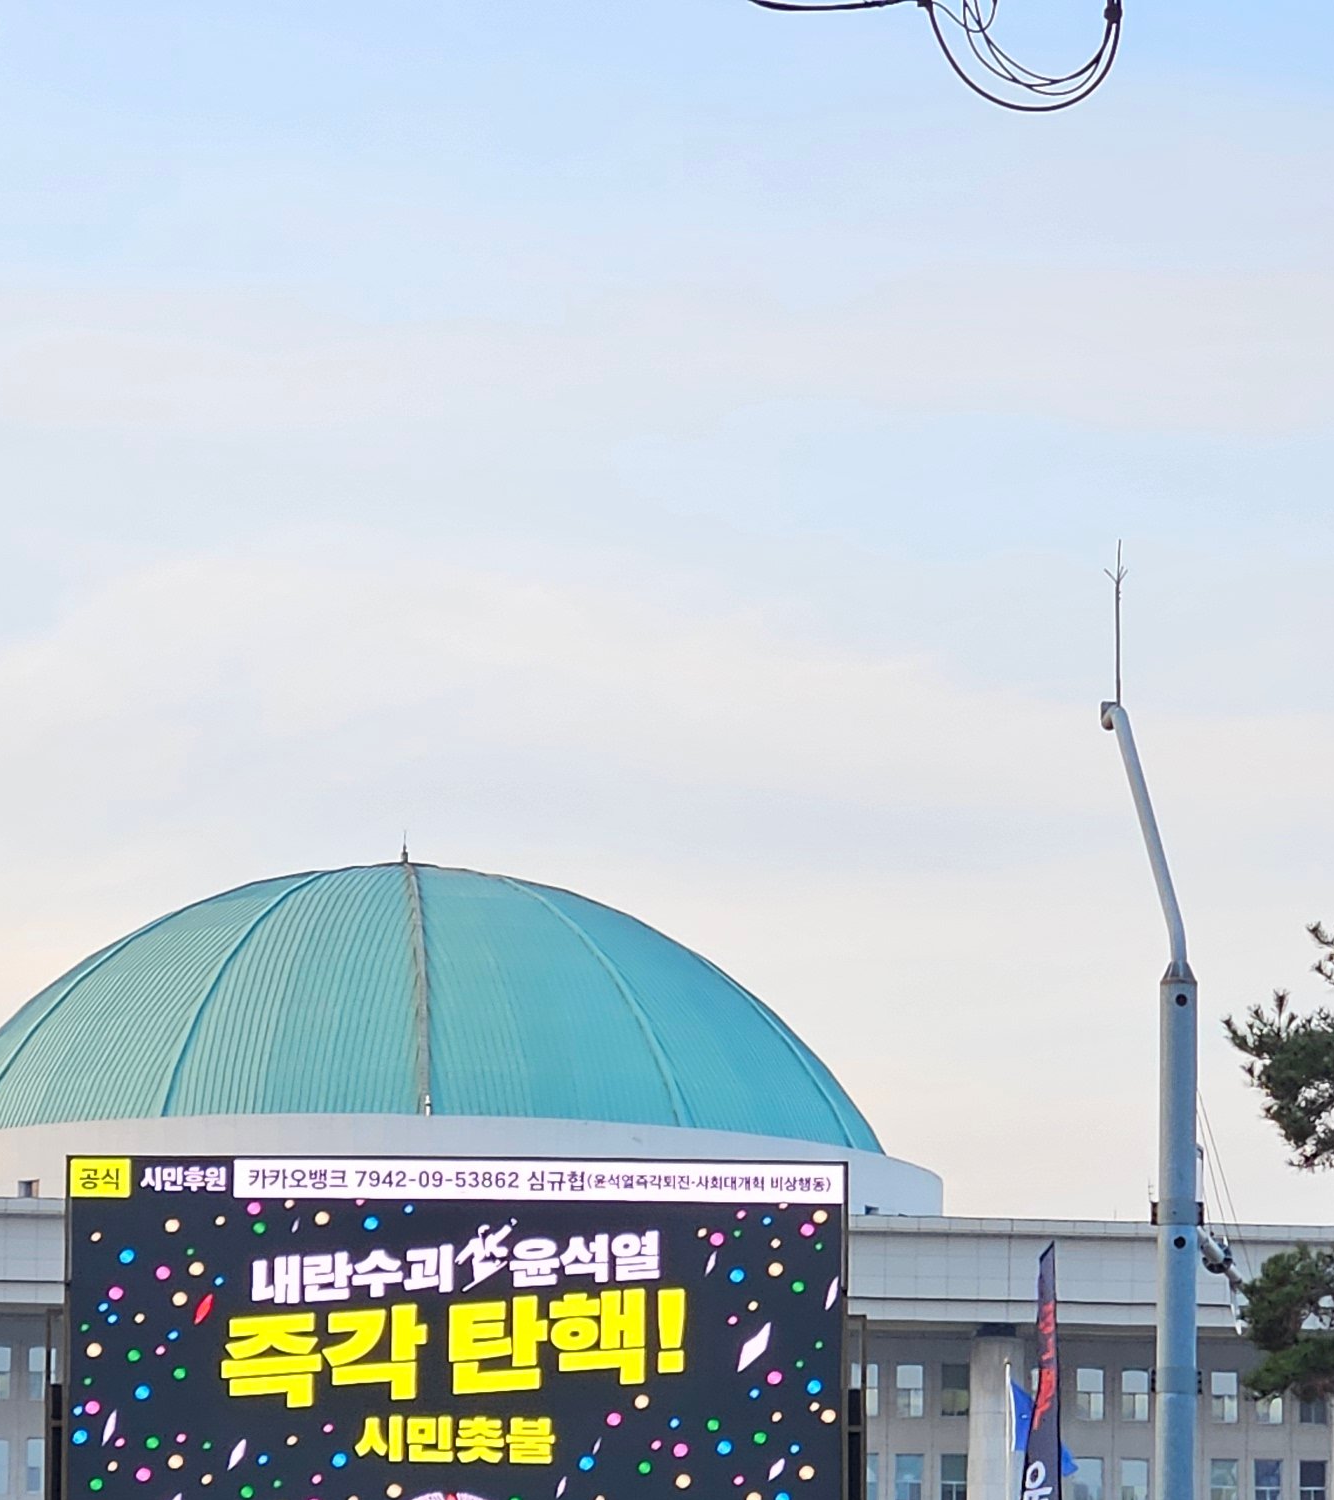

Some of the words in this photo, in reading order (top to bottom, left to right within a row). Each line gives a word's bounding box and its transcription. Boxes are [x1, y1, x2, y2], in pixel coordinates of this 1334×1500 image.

[78, 1167, 121, 1191] 공식
[139, 1166, 228, 1193] 시민후원
[247, 1168, 349, 1190] 카카오뱅크
[354, 1169, 519, 1189] 7942-09-53862
[769, 1176, 832, 1194] 비상행동)
[251, 1243, 455, 1304] 내란수괴
[508, 1230, 661, 1288] 윤석열
[220, 1303, 428, 1409] 즉각
[448, 1288, 686, 1396] 탄핵!
[354, 1414, 556, 1465] 시민촛불
